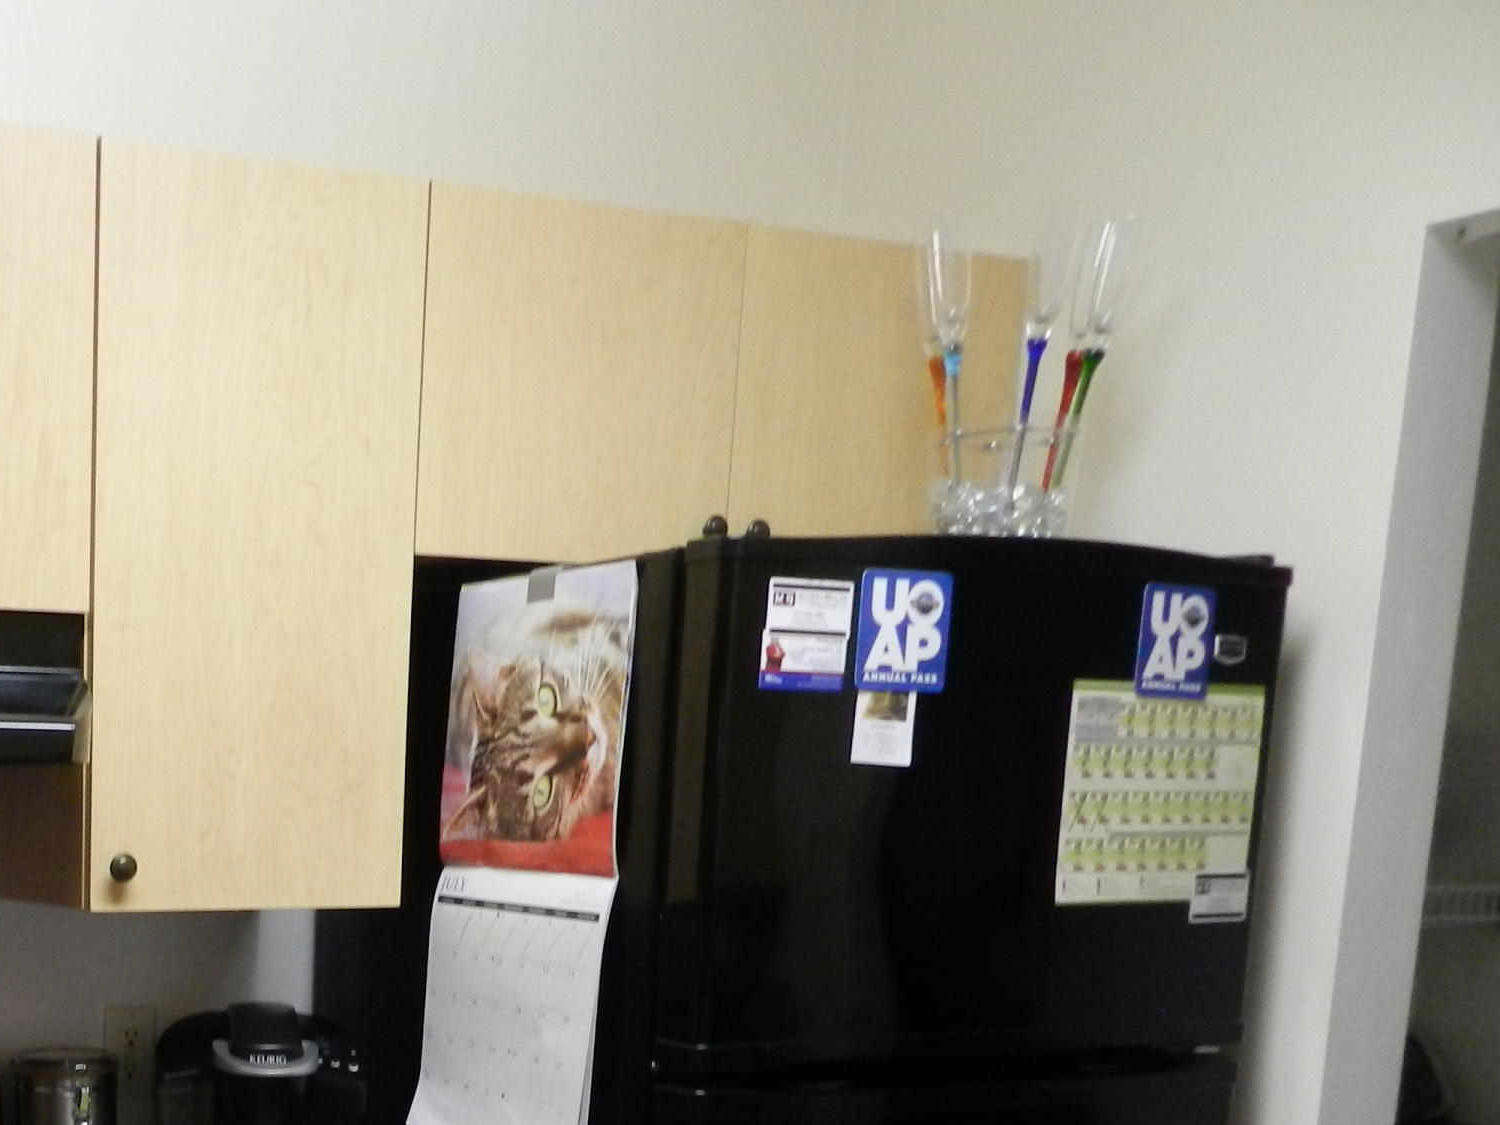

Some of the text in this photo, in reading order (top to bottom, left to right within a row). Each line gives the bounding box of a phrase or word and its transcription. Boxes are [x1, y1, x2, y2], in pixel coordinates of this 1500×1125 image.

[862, 671, 938, 685] ANNUAL PASS
[441, 875, 469, 892] JULY
